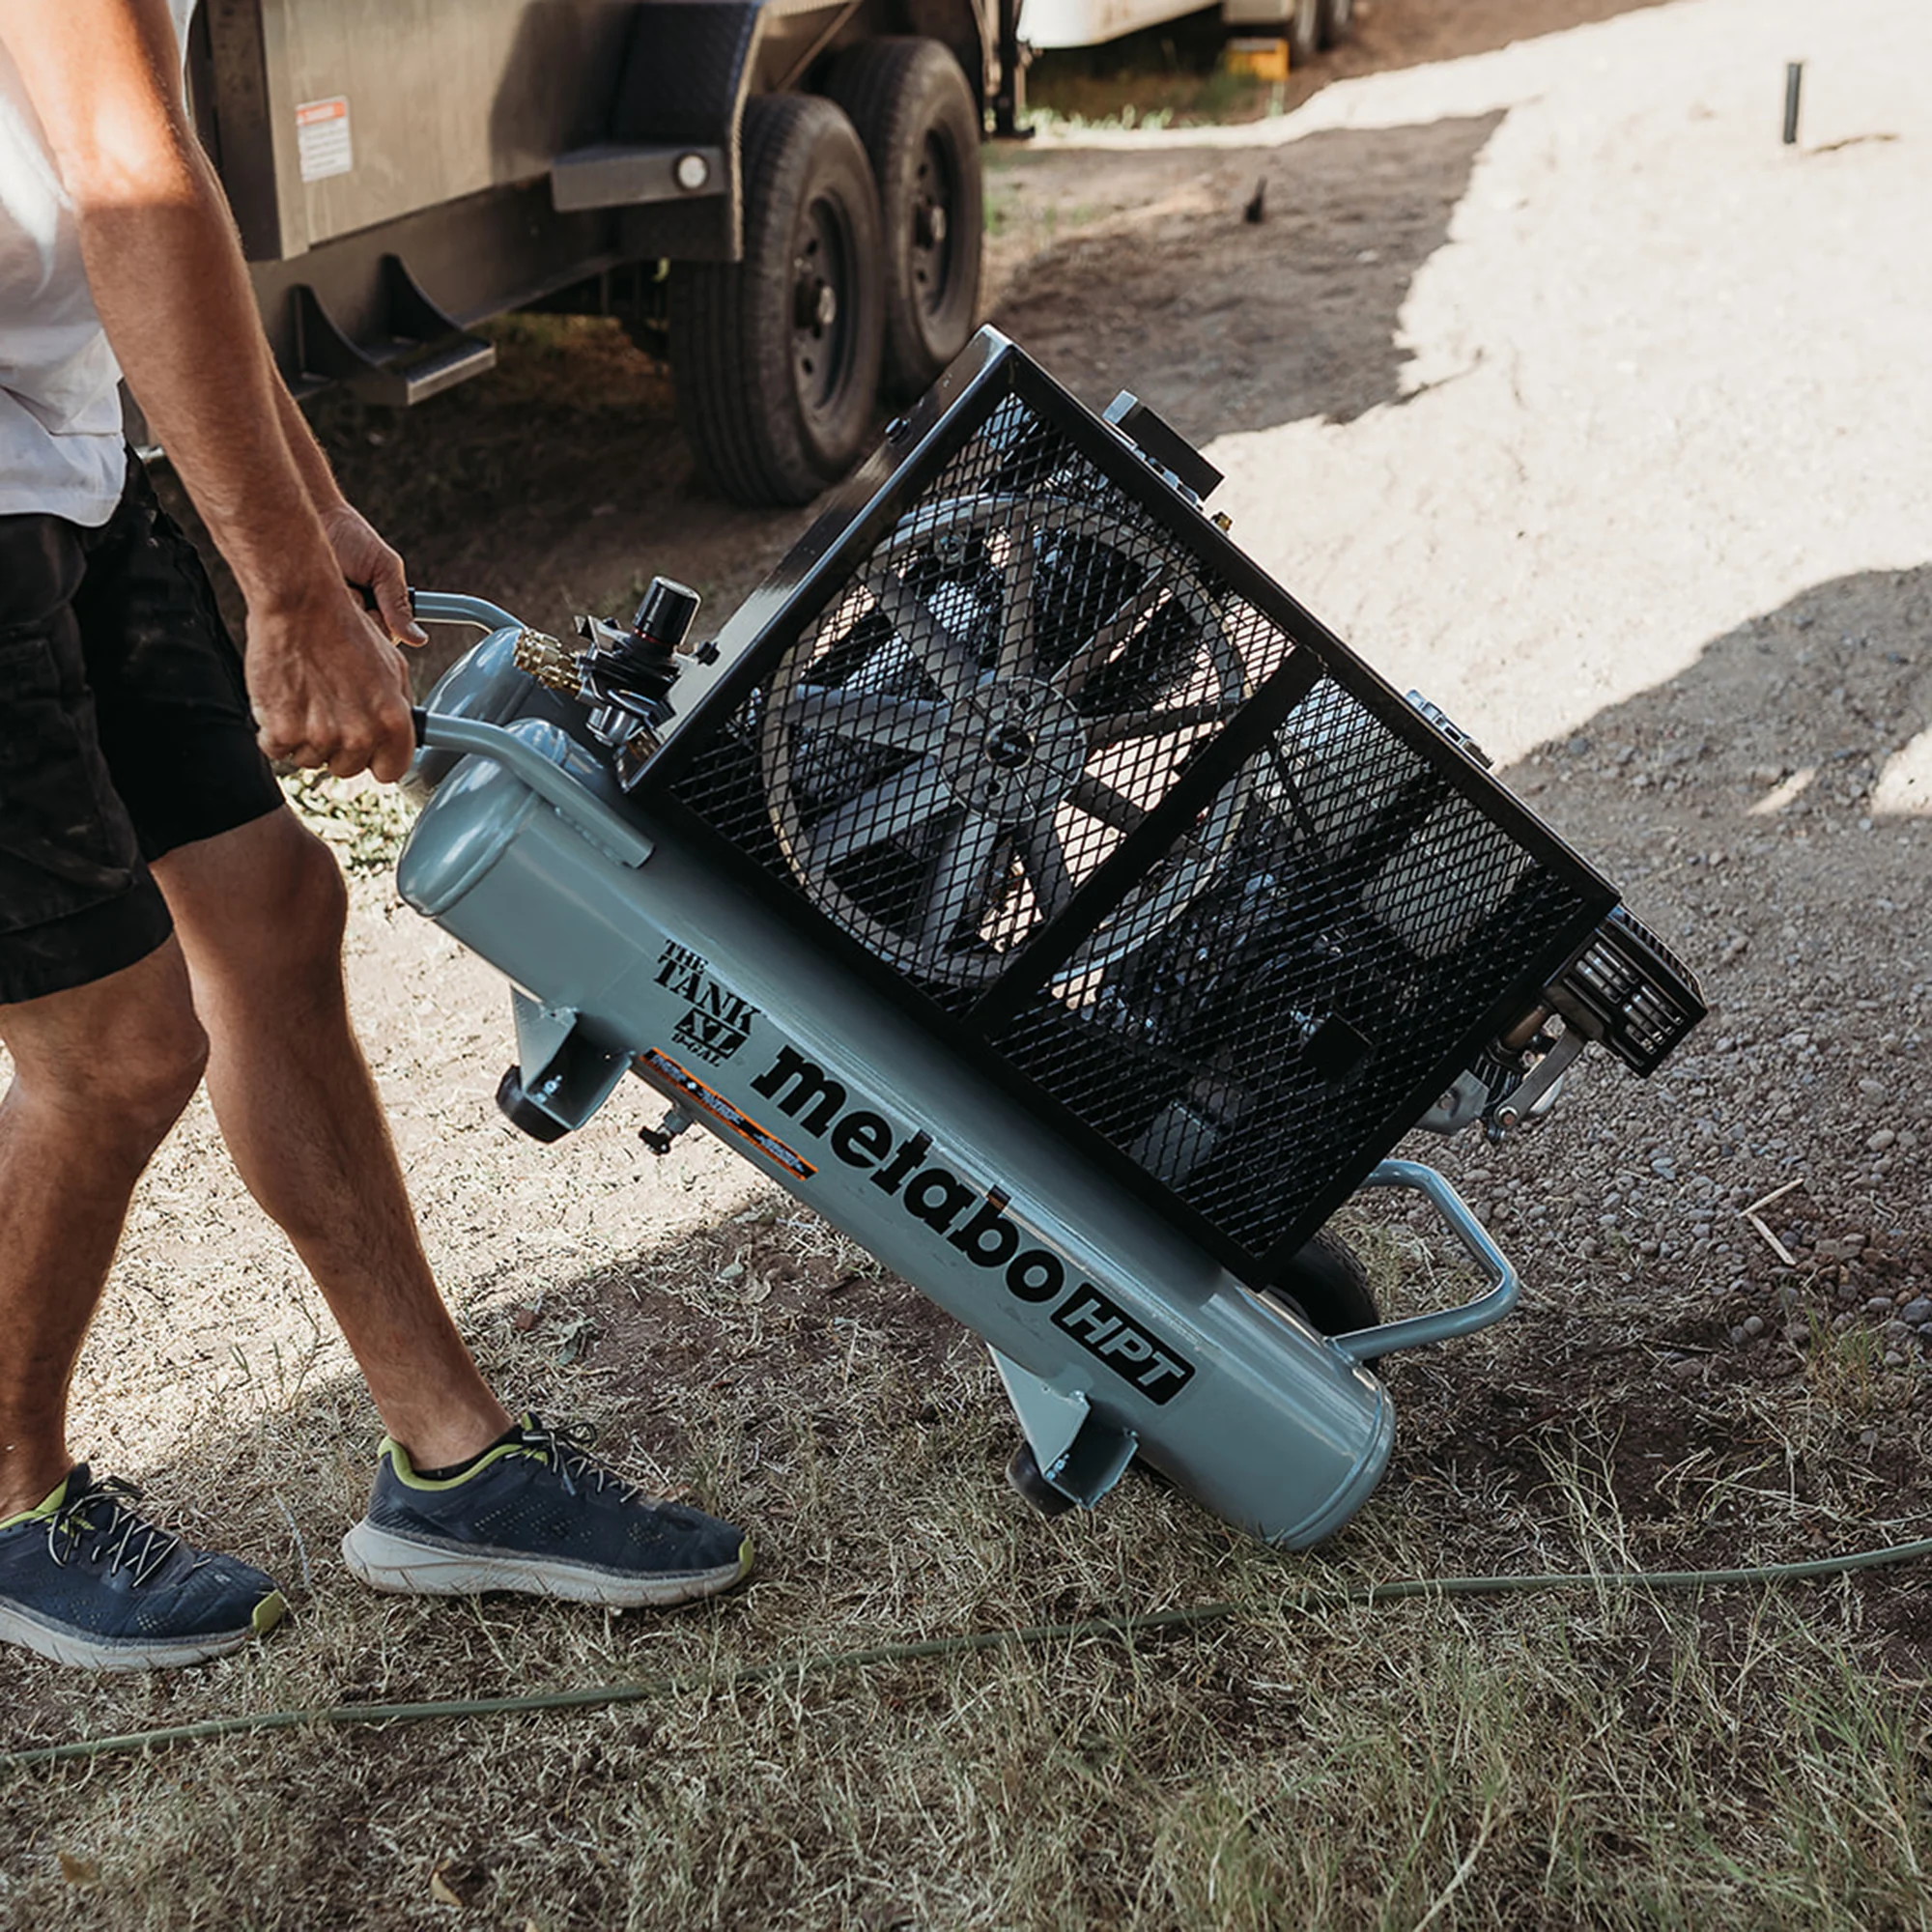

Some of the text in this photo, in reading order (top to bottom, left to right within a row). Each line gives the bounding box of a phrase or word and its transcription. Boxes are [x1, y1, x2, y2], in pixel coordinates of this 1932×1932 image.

[666, 939, 708, 976] THE
[654, 954, 761, 1035] TANK
[677, 1010, 735, 1055] XL
[750, 1044, 1186, 1387] metabo HPT
